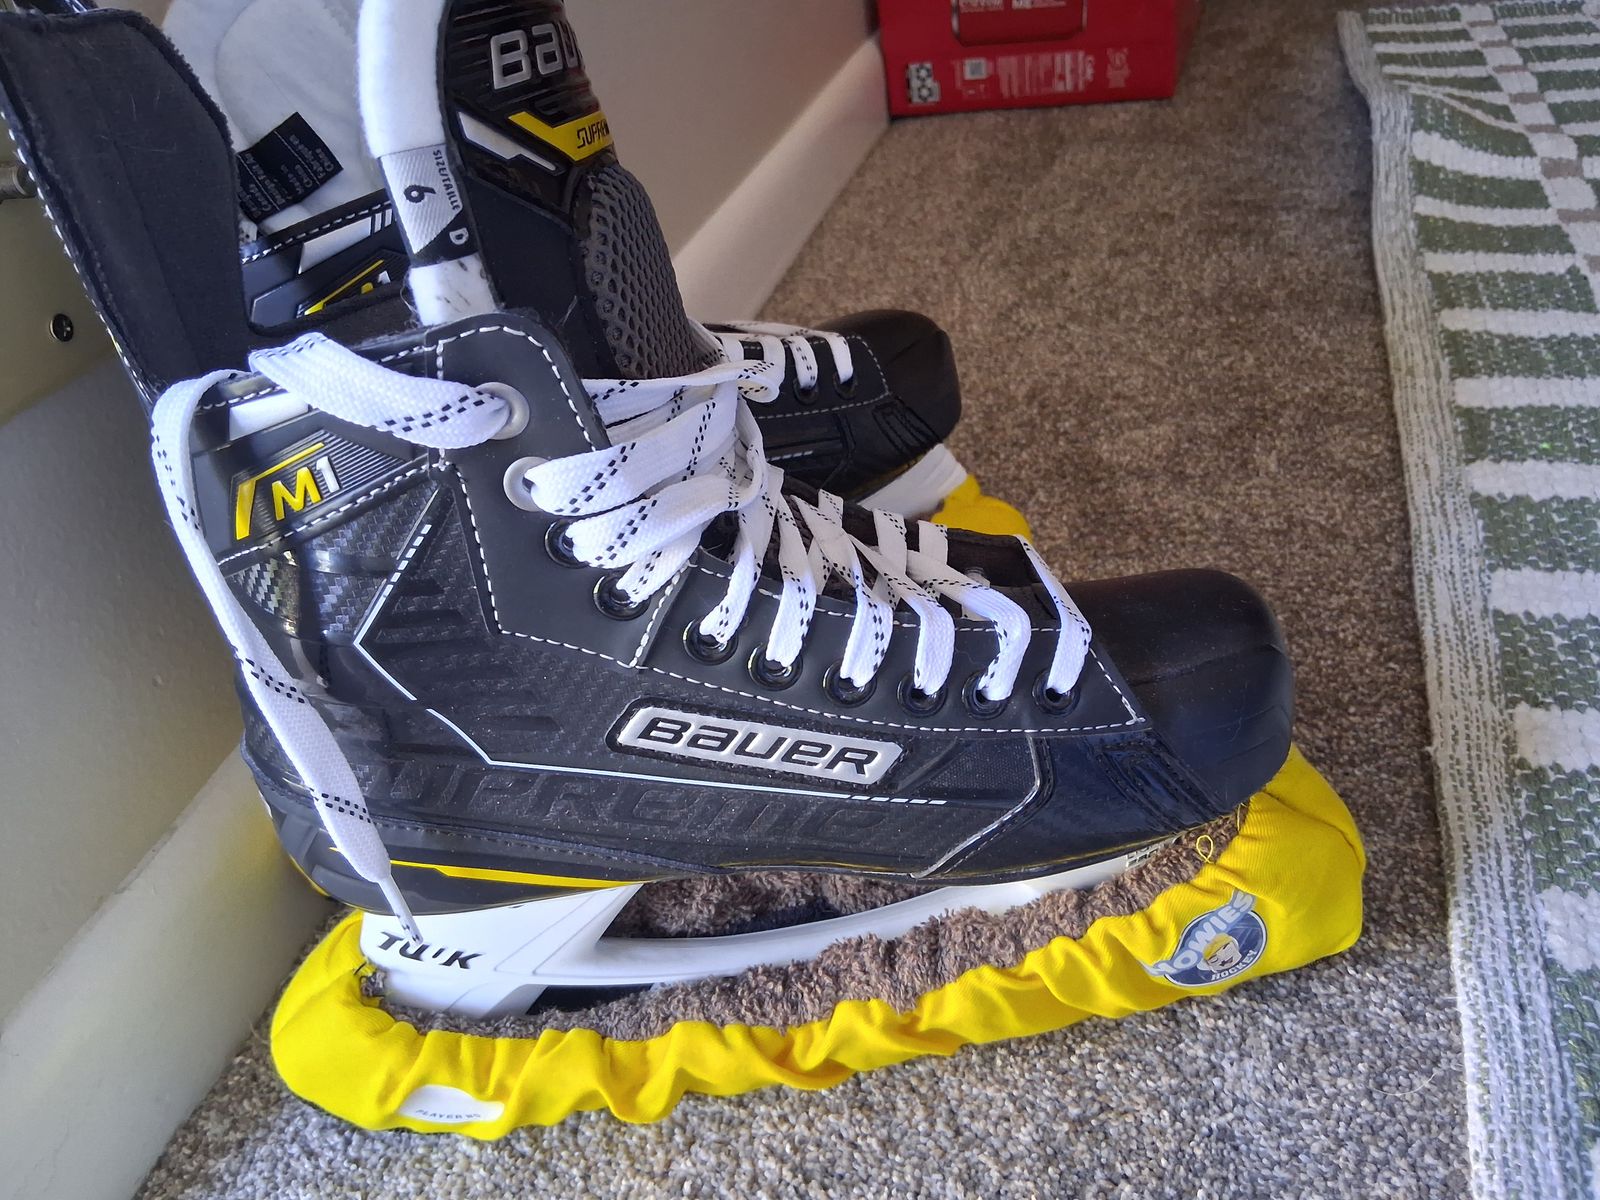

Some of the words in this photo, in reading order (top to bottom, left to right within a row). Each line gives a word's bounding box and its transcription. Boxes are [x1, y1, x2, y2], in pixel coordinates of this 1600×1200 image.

[403, 185, 436, 203] 6
[433, 149, 461, 210] SIZE/TAILLE
[449, 227, 469, 245] D
[272, 456, 340, 520] M1
[1210, 949, 1257, 981] HOCKEY
